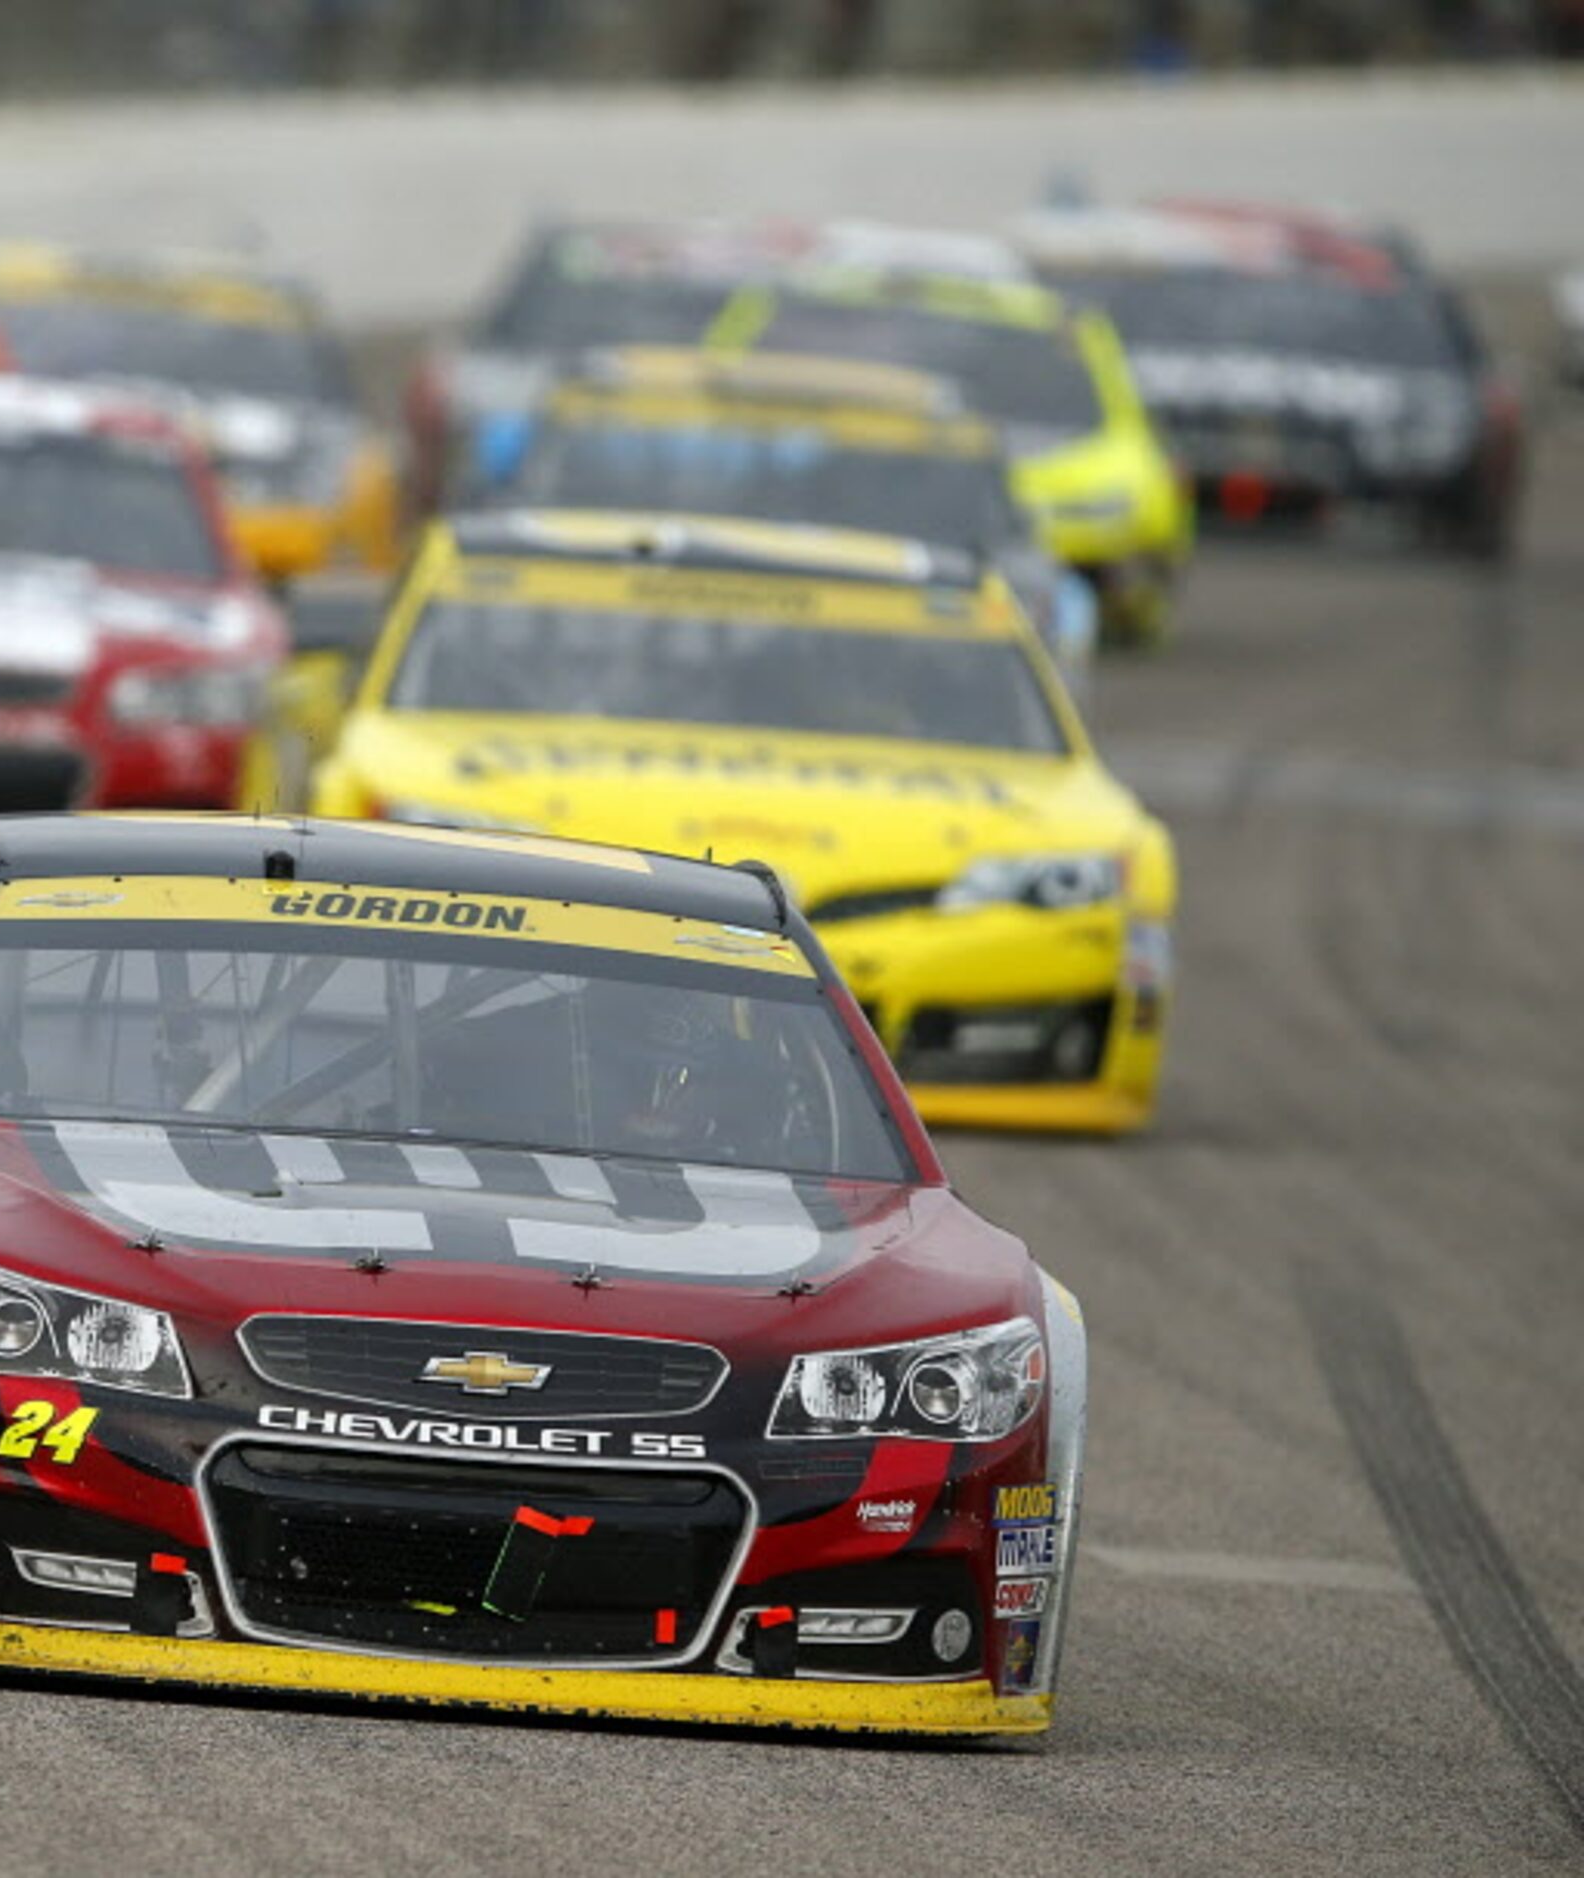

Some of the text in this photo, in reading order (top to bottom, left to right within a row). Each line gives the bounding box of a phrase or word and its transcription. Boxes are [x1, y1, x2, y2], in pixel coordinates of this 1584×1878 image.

[271, 891, 527, 931] GORDON
[258, 1404, 706, 1458] CHEVROLET SS
[995, 1485, 1056, 1520] MOOG
